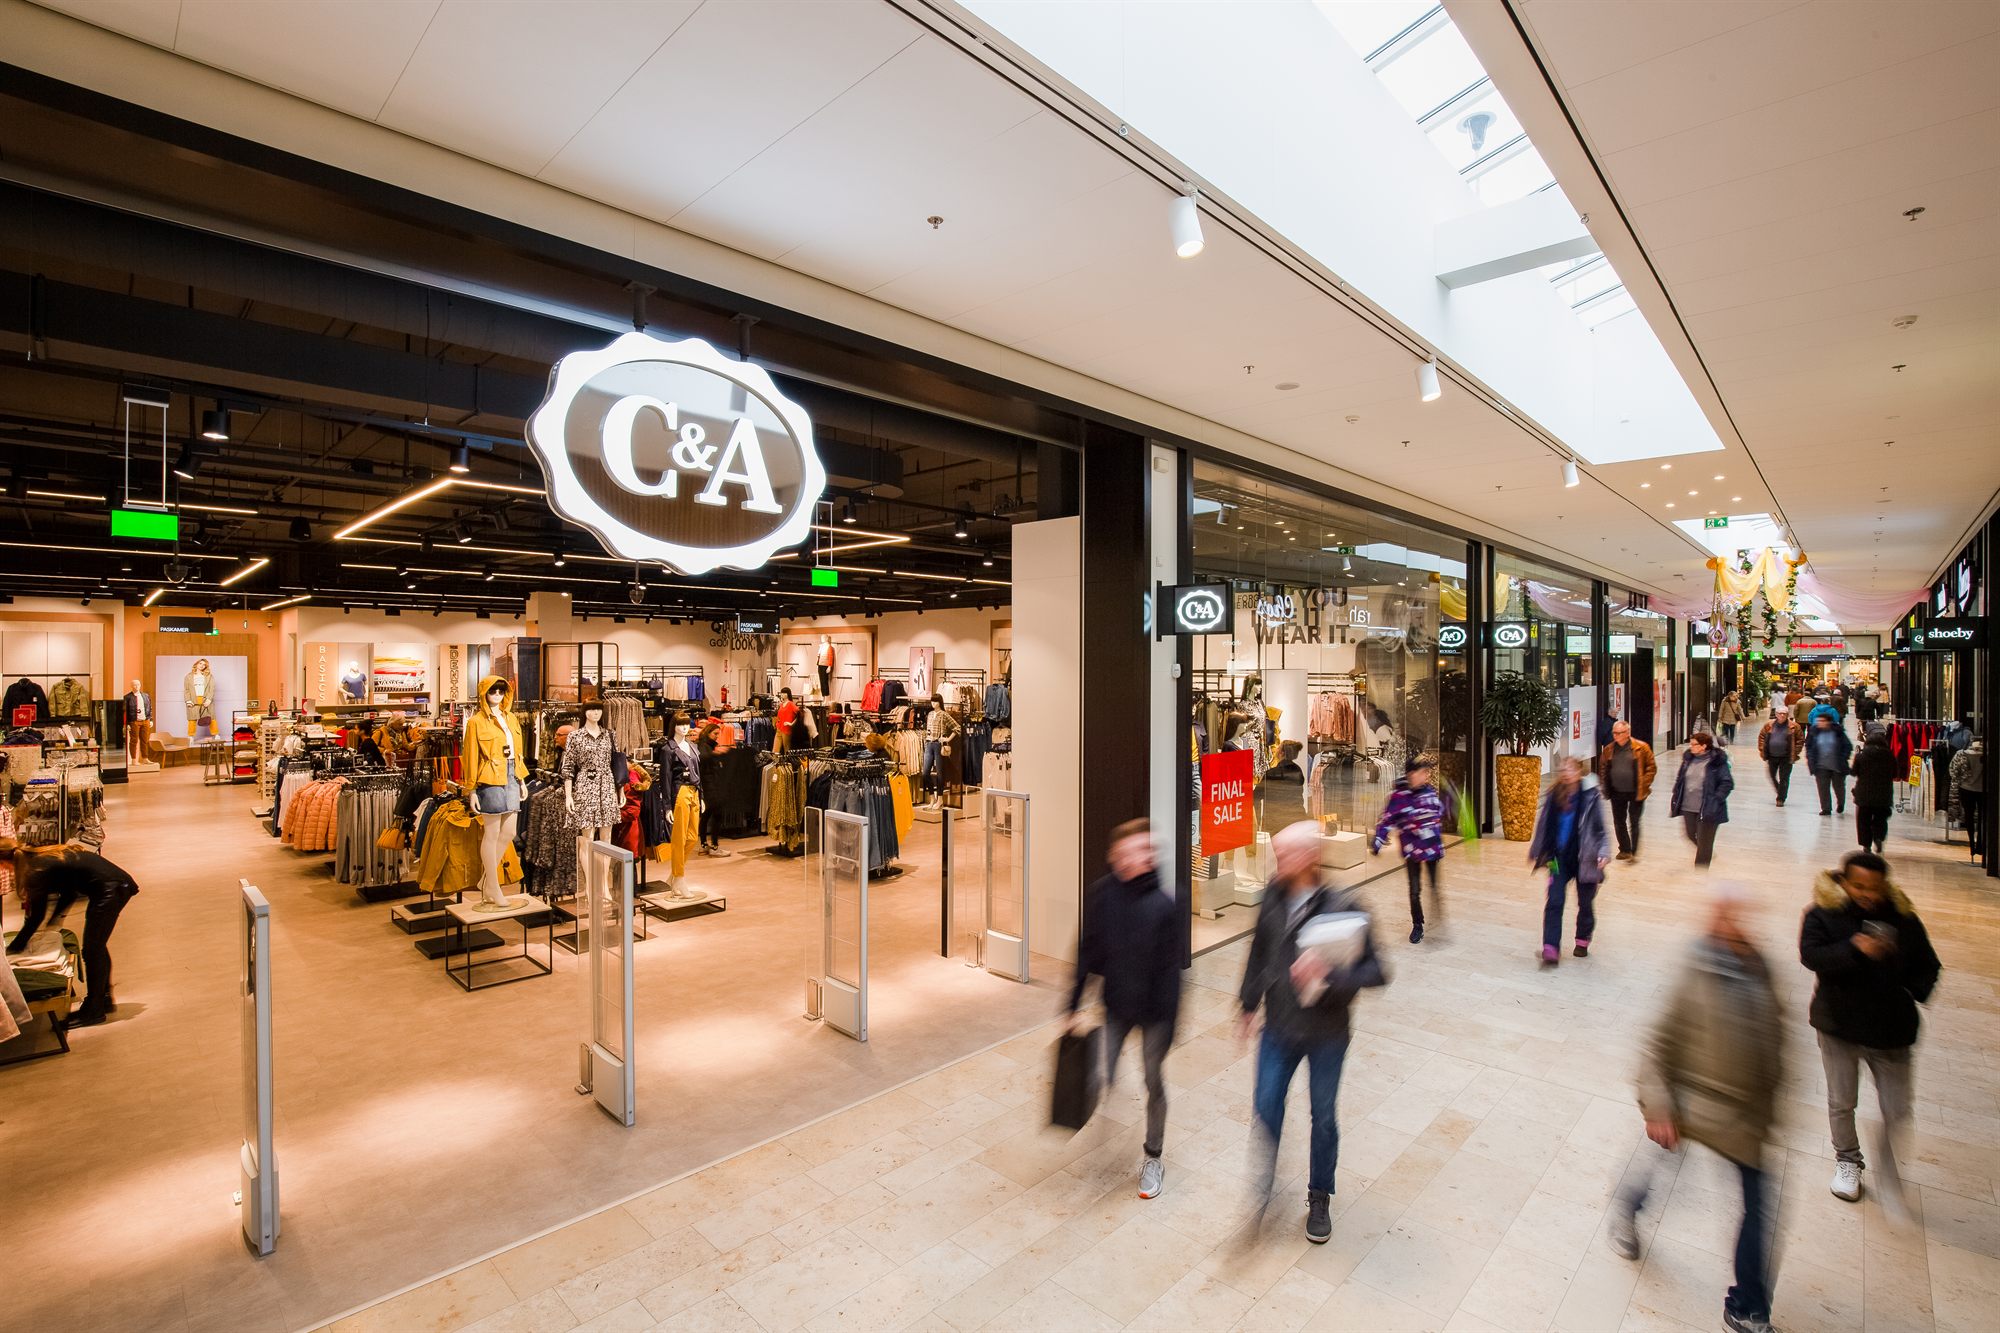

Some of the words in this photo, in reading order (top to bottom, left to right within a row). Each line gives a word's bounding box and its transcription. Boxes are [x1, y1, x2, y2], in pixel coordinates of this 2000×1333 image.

[602, 394, 783, 514] C&A
[1299, 587, 1348, 608] YOU
[1185, 600, 1216, 619] C&A
[1252, 625, 1322, 645] WEAR
[1329, 625, 1356, 645] IT.
[1500, 630, 1520, 641] C&A
[1928, 627, 1974, 640] shoeby
[318, 645, 327, 701] BASICS
[450, 649, 459, 701] DENIM
[1211, 779, 1245, 802] FINAL
[1213, 802, 1243, 825] SALE
